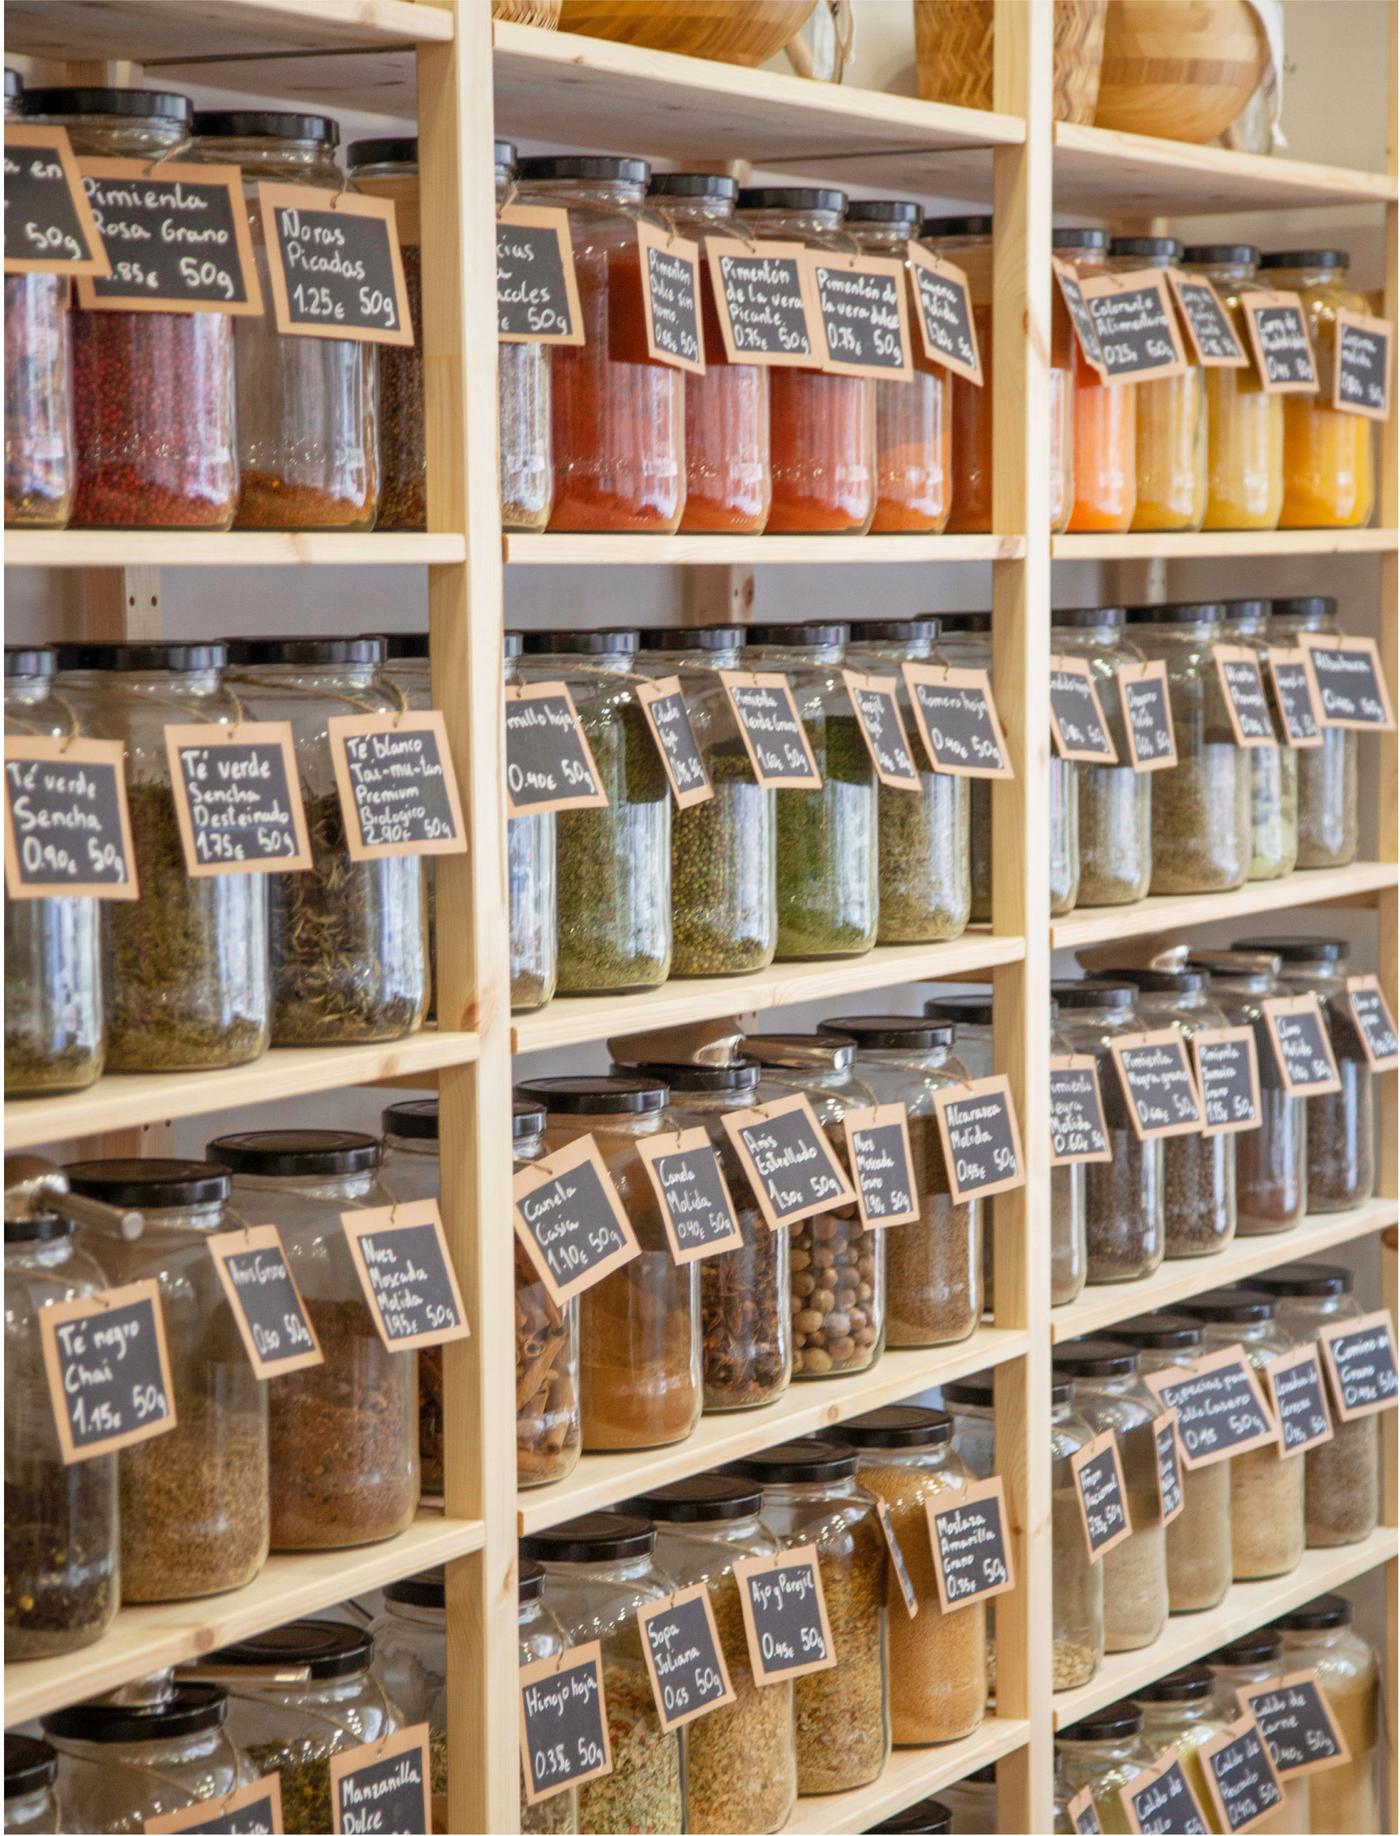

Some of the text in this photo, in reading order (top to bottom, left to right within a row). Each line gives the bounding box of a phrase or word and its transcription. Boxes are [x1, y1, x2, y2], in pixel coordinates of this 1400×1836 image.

[30, 159, 62, 179] en
[25, 221, 82, 260] 50g
[161, 218, 229, 243] Grano
[286, 241, 365, 279] Picadas
[720, 256, 790, 284] Pimentón
[179, 256, 234, 299] 50g
[816, 268, 880, 300] Pimentón
[293, 284, 395, 326] 1.25€ 50g
[726, 281, 804, 309] de vera
[821, 291, 835, 312] la
[837, 302, 869, 318] vera
[1090, 294, 1153, 318] Colorante
[527, 309, 568, 335] 50g
[680, 330, 700, 362] 50g
[733, 324, 809, 354] 0.75€ 50g
[827, 322, 902, 365] 0.75€ 50g
[957, 335, 976, 369] 50g
[1145, 339, 1178, 363] 50g
[917, 685, 988, 720] Romero hoja
[1360, 697, 1385, 722] 50g
[544, 705, 574, 732] hoja
[347, 734, 423, 759] Té blanco
[784, 744, 809, 773] 50g
[971, 735, 1004, 769] 50g
[181, 750, 271, 780] Té verde
[508, 759, 595, 793] 0.40€ 50g
[894, 749, 915, 778] 50g
[6, 762, 97, 799] Té verde
[188, 781, 260, 803] Sencha
[355, 784, 419, 804] Premium
[13, 796, 102, 832] Sencha
[193, 801, 289, 828] Desteinado
[424, 816, 452, 839] 50g
[196, 826, 295, 860] 1.75€ 50g
[23, 836, 125, 884] 0.90€ 50g
[1121, 1048, 1173, 1070] Pimienta
[1172, 1093, 1199, 1120] 50g
[1234, 1095, 1256, 1120] 50g
[951, 1125, 993, 1150] Molida
[755, 1140, 818, 1176] Estrellado
[857, 1149, 896, 1171] Moscada
[993, 1147, 1019, 1178] 50g
[659, 1159, 696, 1188] Canela
[810, 1175, 842, 1200] 50g
[523, 1181, 576, 1222] Canela
[667, 1189, 712, 1214] Molida
[890, 1190, 912, 1213] 50g
[535, 1213, 579, 1247] Casia
[677, 1211, 733, 1240] 0.40€ 50g
[361, 1237, 397, 1264] Nuez
[547, 1226, 622, 1275] 1.10€ 50g
[369, 1260, 428, 1289] Moscada
[378, 1289, 424, 1312] Molida
[284, 1313, 313, 1346] 50g
[425, 1303, 456, 1329] 50g
[57, 1320, 140, 1361] Té negro
[64, 1358, 113, 1393] Chai
[1341, 1364, 1376, 1383] Grano
[1163, 1375, 1222, 1408] Especias
[1205, 1394, 1250, 1417] Casero
[72, 1384, 167, 1435] 1.15€ 50g
[1228, 1413, 1265, 1436] 50g
[936, 1510, 987, 1537] Mostaza
[1106, 1502, 1124, 1526] 50g
[941, 1528, 996, 1556] Amarilla
[943, 1553, 975, 1574] Grano
[982, 1557, 1007, 1585] 50g
[752, 1580, 773, 1611] Ajo
[647, 1622, 680, 1649] Sopa
[799, 1626, 826, 1659] 50g
[654, 1645, 701, 1676] Juliana
[525, 1672, 598, 1717] Hinojo hoja
[694, 1666, 723, 1697] 50g
[1252, 1690, 1306, 1718] Caldo de
[1260, 1715, 1300, 1737] Carne
[578, 1736, 604, 1772] 50g
[1305, 1729, 1335, 1755] 50g
[1214, 1739, 1261, 1778] Caldo de
[343, 1762, 421, 1806] Manzanilla
[1135, 1773, 1184, 1823] Caldo de
[1258, 1782, 1280, 1804] 50g
[344, 1808, 382, 1835] Dulce
